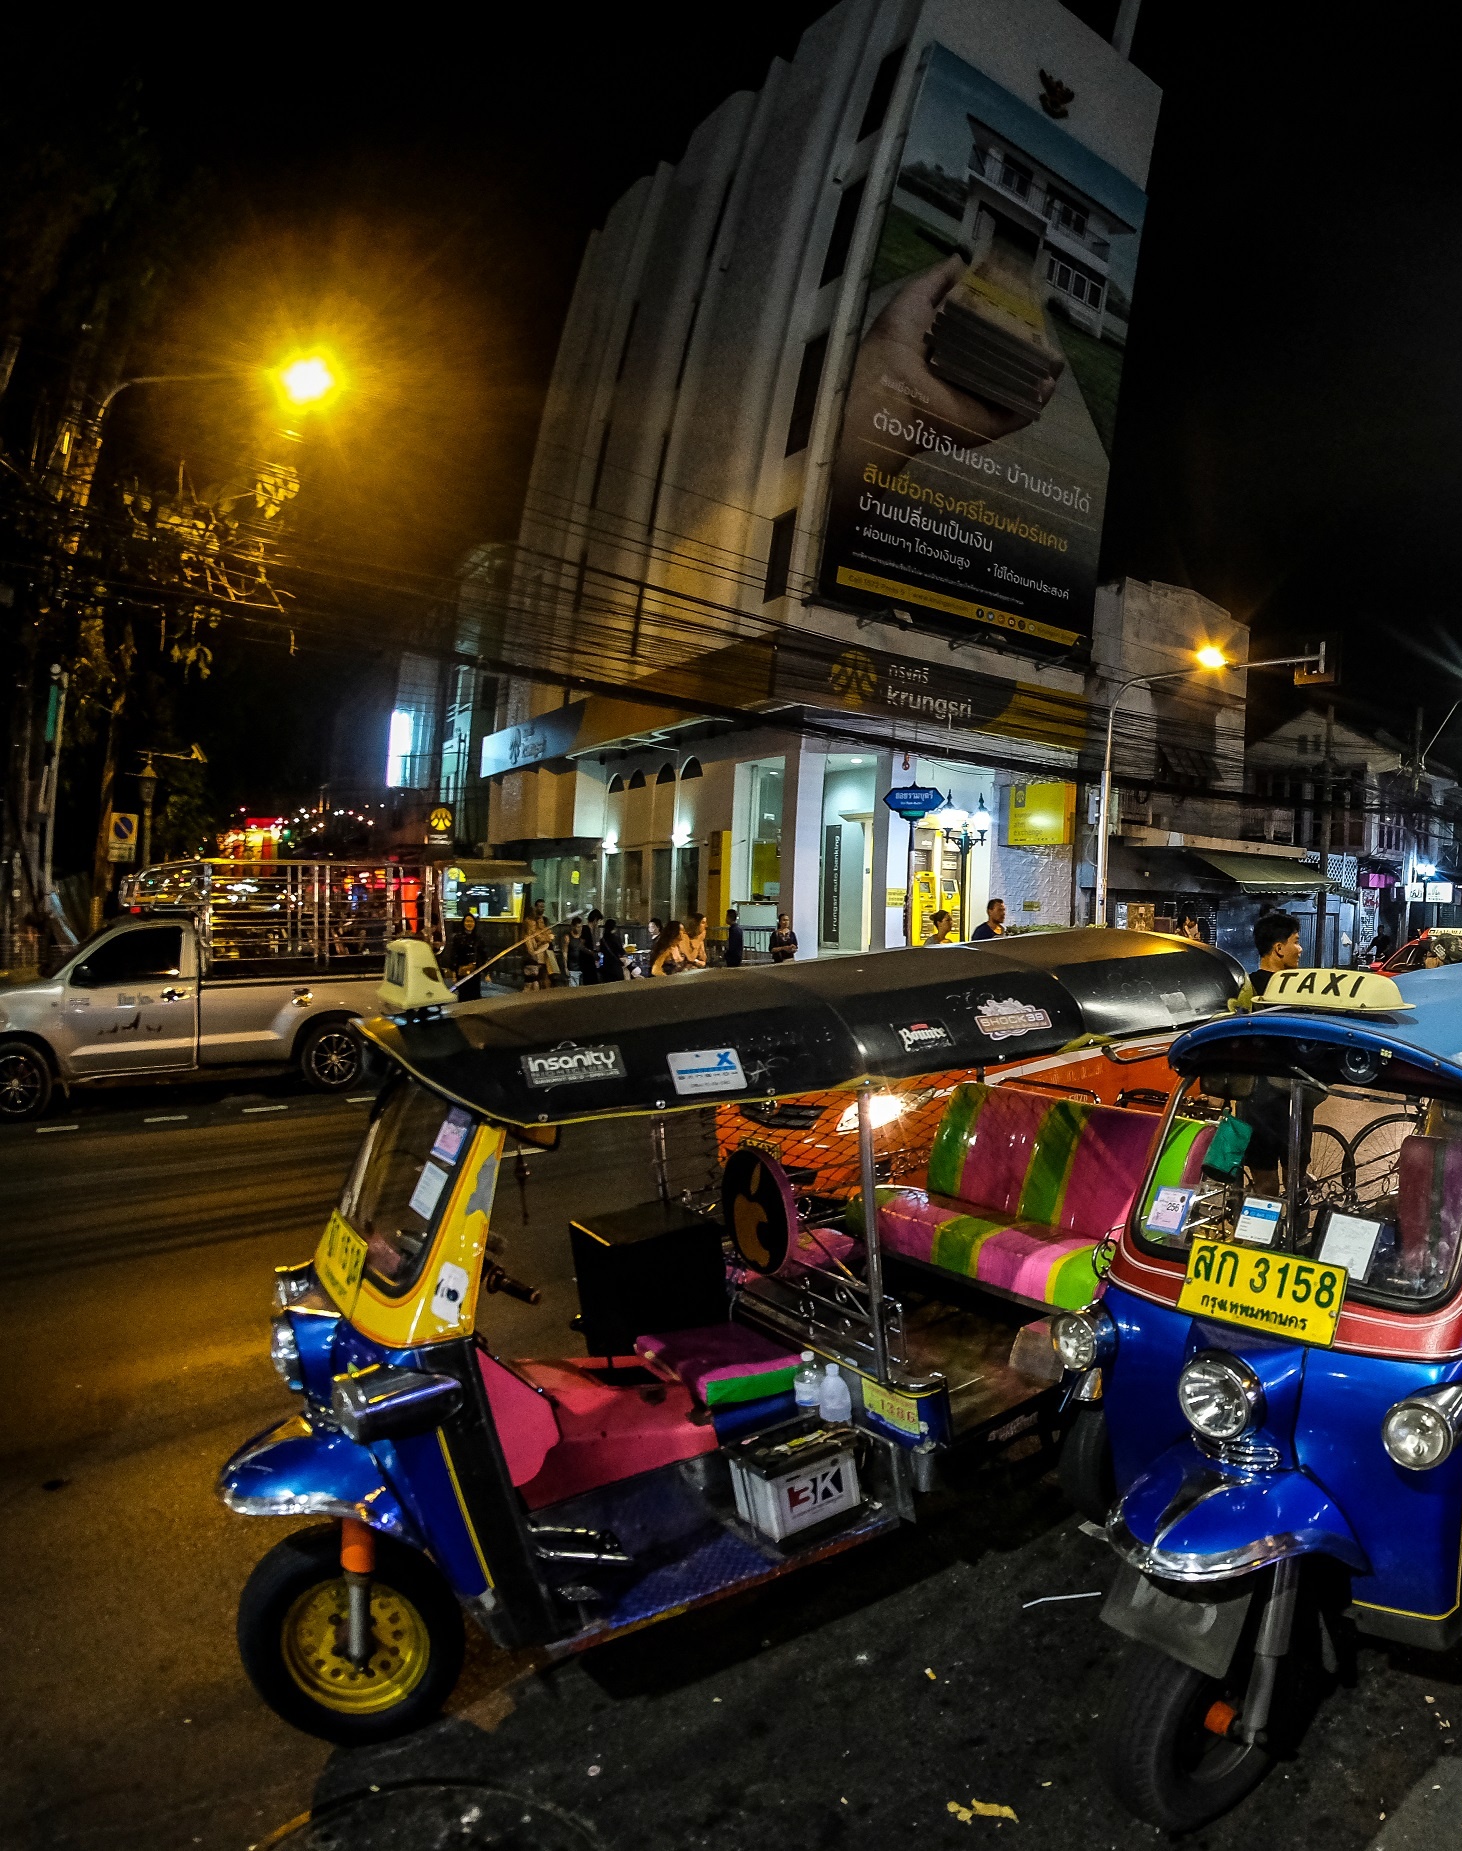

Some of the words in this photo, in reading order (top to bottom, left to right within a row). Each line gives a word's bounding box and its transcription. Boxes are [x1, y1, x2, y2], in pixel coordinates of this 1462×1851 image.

[873, 408, 1001, 476] ต้องใช้เงินเยอะ
[1007, 462, 1091, 514] บ้านช่วยได้
[858, 493, 994, 553] บ้านเปลี่ยนเป็นเงิน
[862, 462, 1069, 553] สินเชื่อกรุงศรีโฮมฟอร์แคช
[886, 685, 973, 720] krungsri
[1278, 972, 1366, 998] TAXI
[527, 1050, 616, 1072] insanity
[1193, 1245, 1240, 1288] สก
[1249, 1257, 1337, 1309] 3158
[1200, 1292, 1309, 1331] กรุงเทพมหานคร
